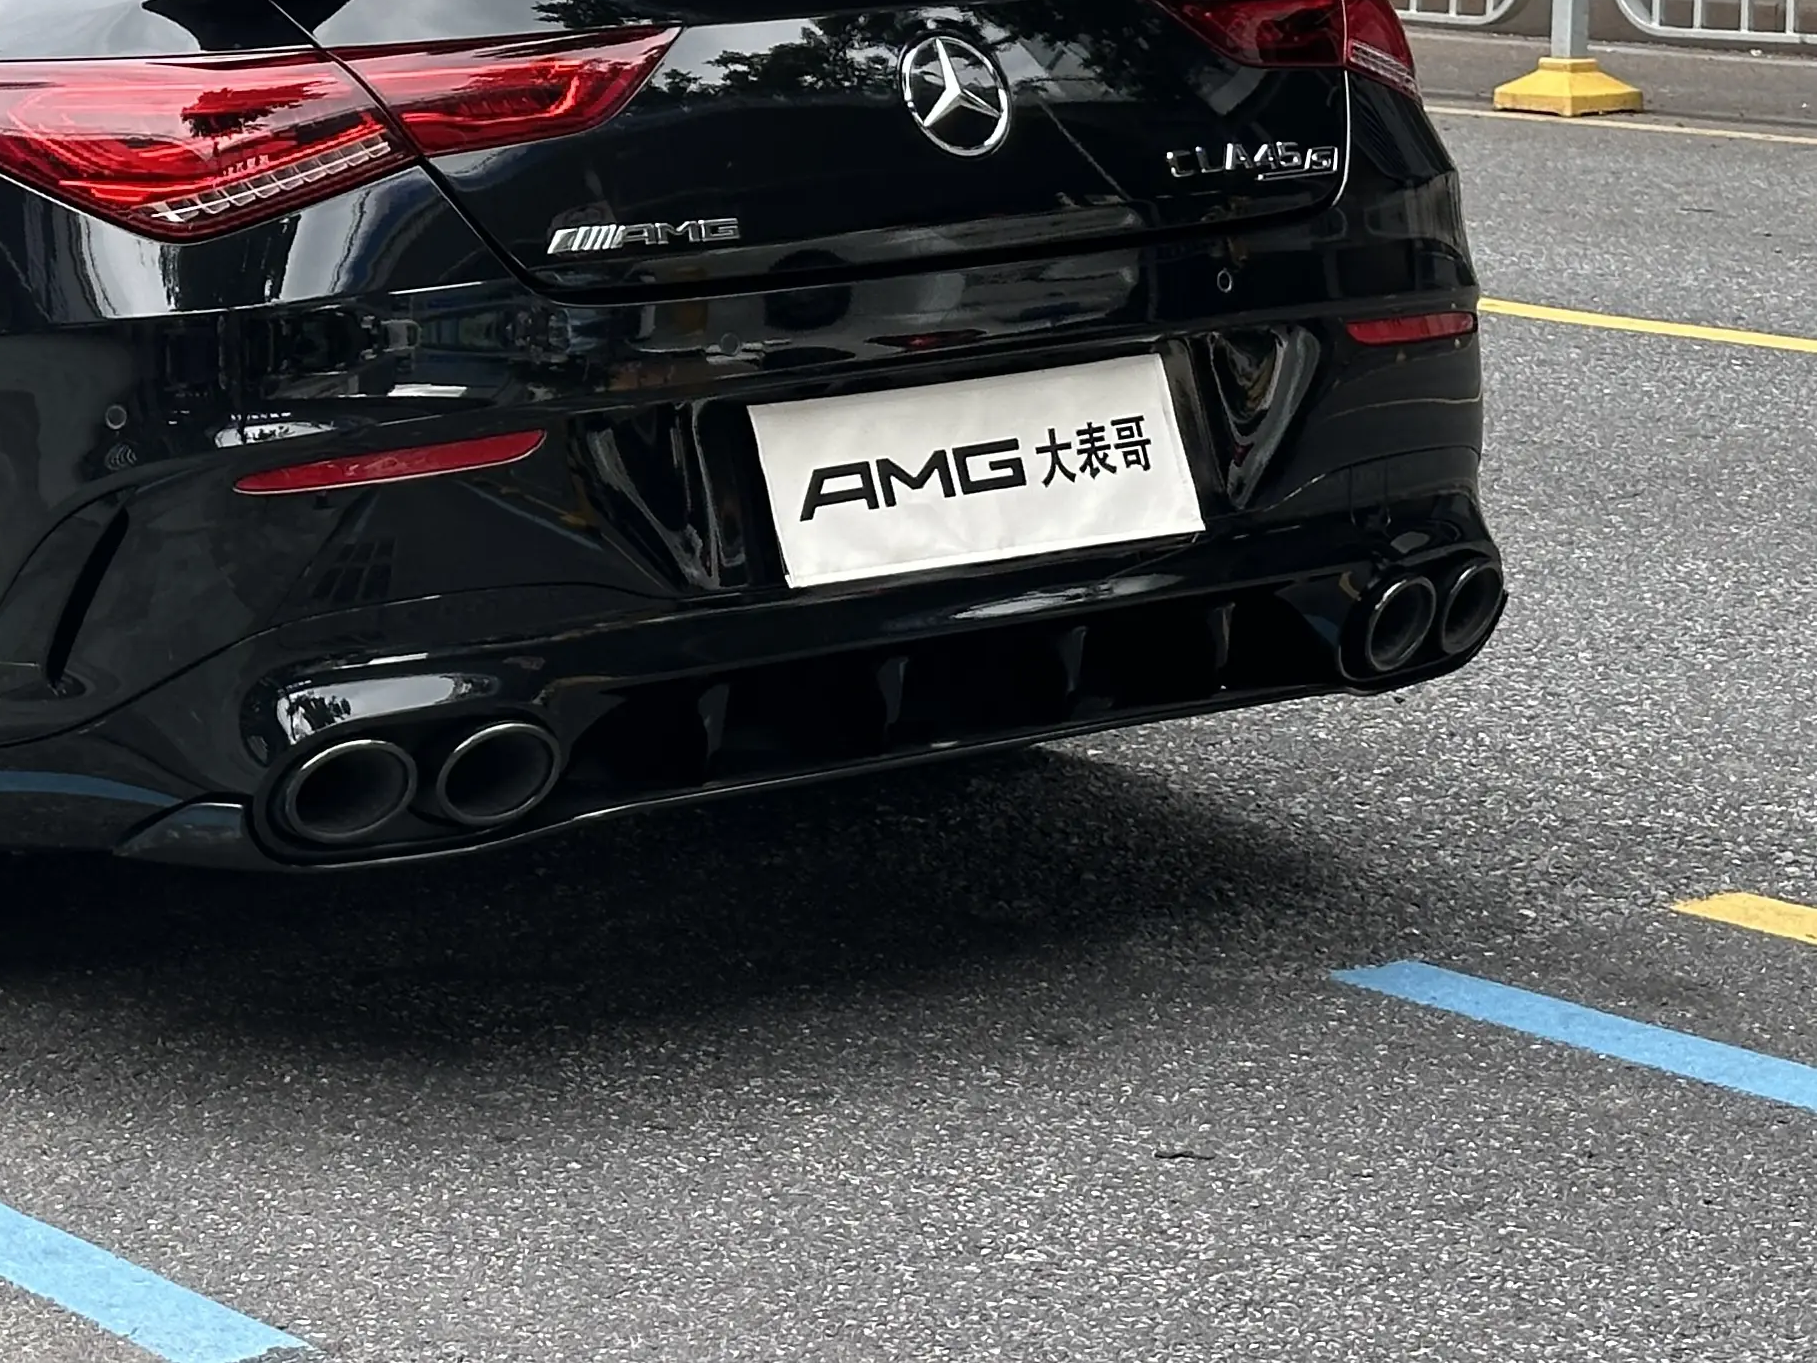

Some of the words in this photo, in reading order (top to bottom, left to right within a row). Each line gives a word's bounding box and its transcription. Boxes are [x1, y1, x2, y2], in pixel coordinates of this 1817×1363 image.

[799, 438, 1027, 522] AMG
[1035, 415, 1152, 488] 大表哥
